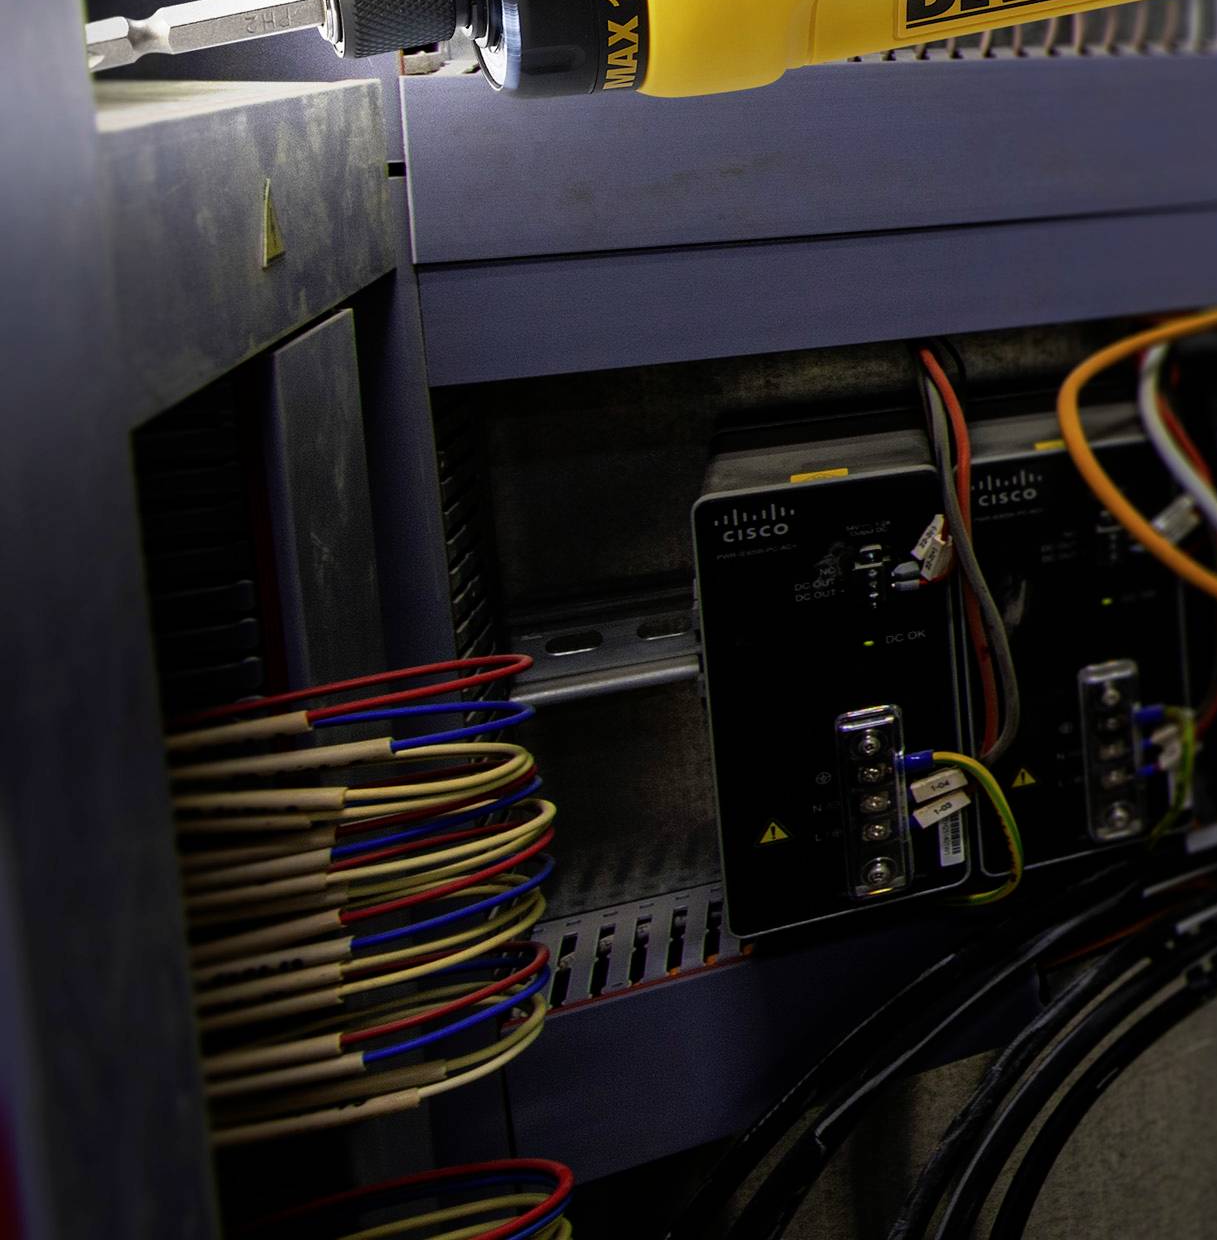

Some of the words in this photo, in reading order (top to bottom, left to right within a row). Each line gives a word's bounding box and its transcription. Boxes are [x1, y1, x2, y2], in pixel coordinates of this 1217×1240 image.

[244, 6, 291, 34] PH2
[602, 15, 640, 91] MAX
[794, 582, 811, 593] DC
[795, 591, 812, 603] DC
[813, 588, 837, 600] OUT
[885, 633, 905, 645] DC
[907, 628, 927, 640] OK
[930, 779, 950, 792] 1-04
